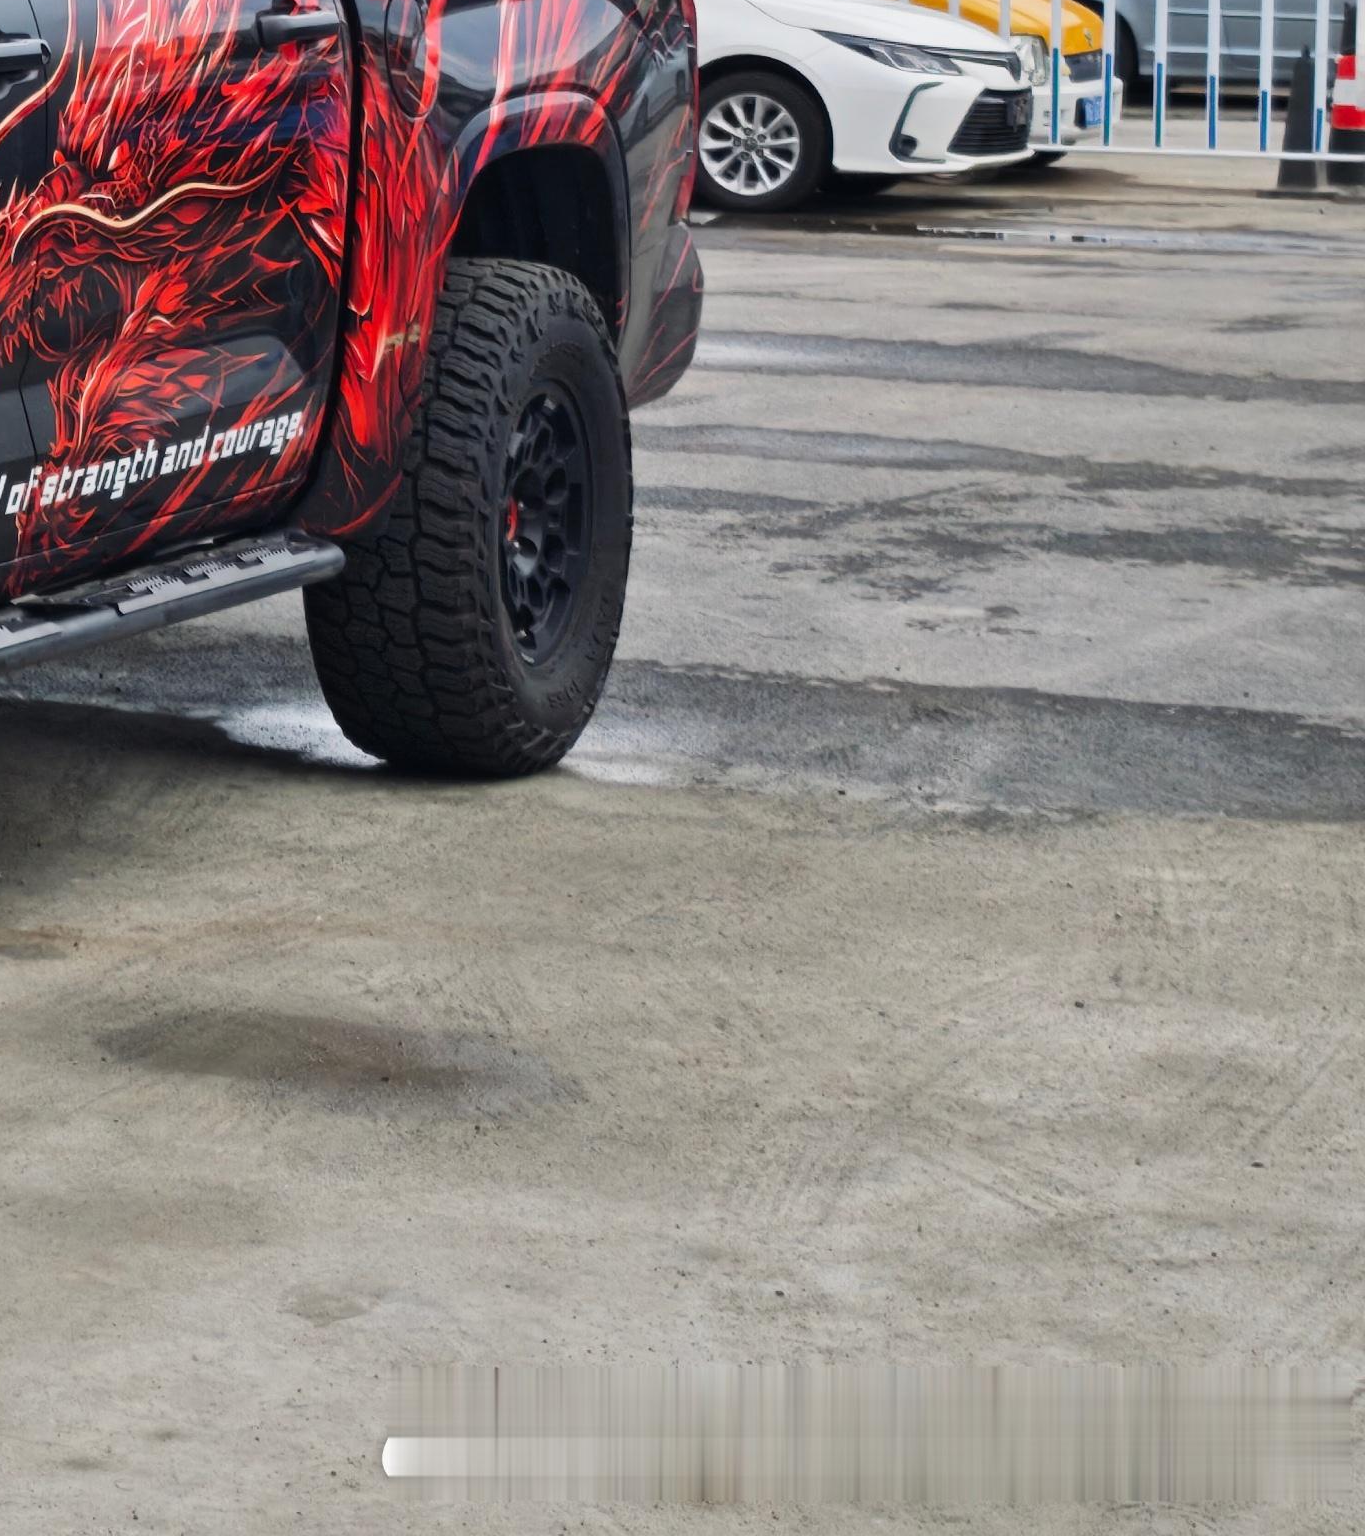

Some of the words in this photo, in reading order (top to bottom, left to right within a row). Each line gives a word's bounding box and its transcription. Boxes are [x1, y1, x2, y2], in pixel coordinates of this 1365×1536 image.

[6, 466, 43, 515] of
[40, 438, 157, 506] strangth
[162, 425, 210, 471] and
[209, 411, 303, 462] courage.
